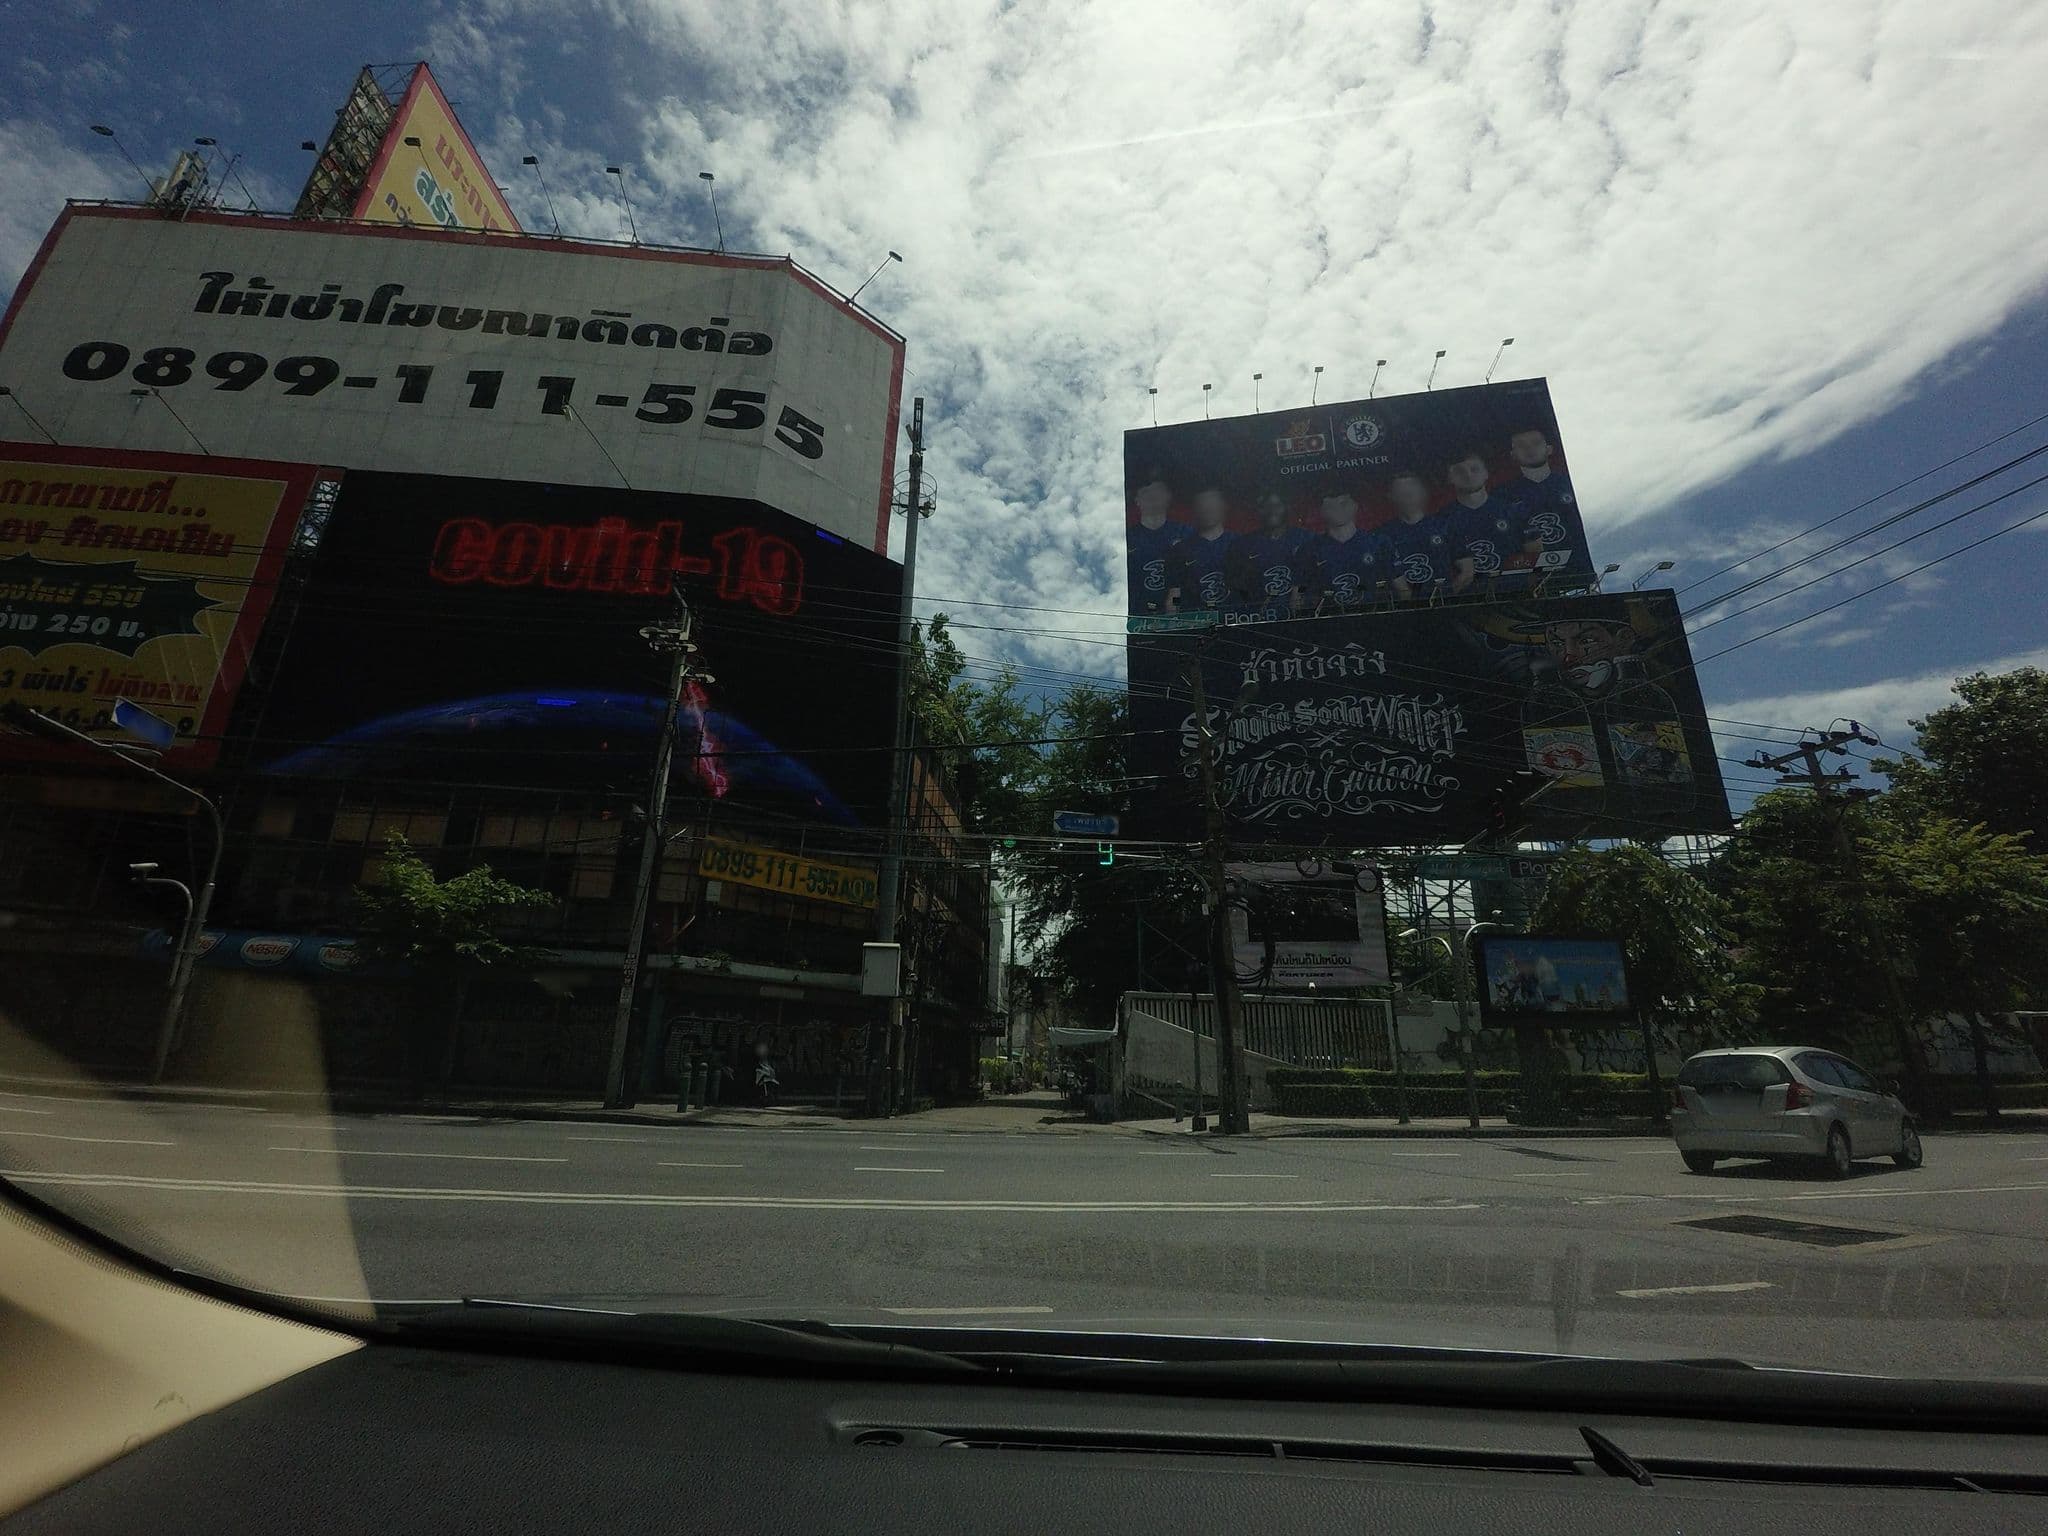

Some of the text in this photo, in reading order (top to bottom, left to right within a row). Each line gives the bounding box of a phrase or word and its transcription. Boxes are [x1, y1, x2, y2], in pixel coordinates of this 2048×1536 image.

[194, 271, 774, 356] ให้เช่าโฆษณาติดต่อ
[62, 341, 825, 460] 0899-111-555
[1280, 461, 1331, 475] OFFICIAL
[1336, 455, 1390, 469] PARTNER
[44, 614, 111, 636] 250
[1224, 611, 1264, 627] Plan
[1294, 696, 1366, 736] Soda
[1358, 692, 1468, 759] Water
[1216, 749, 1440, 806] Mister Cartoon
